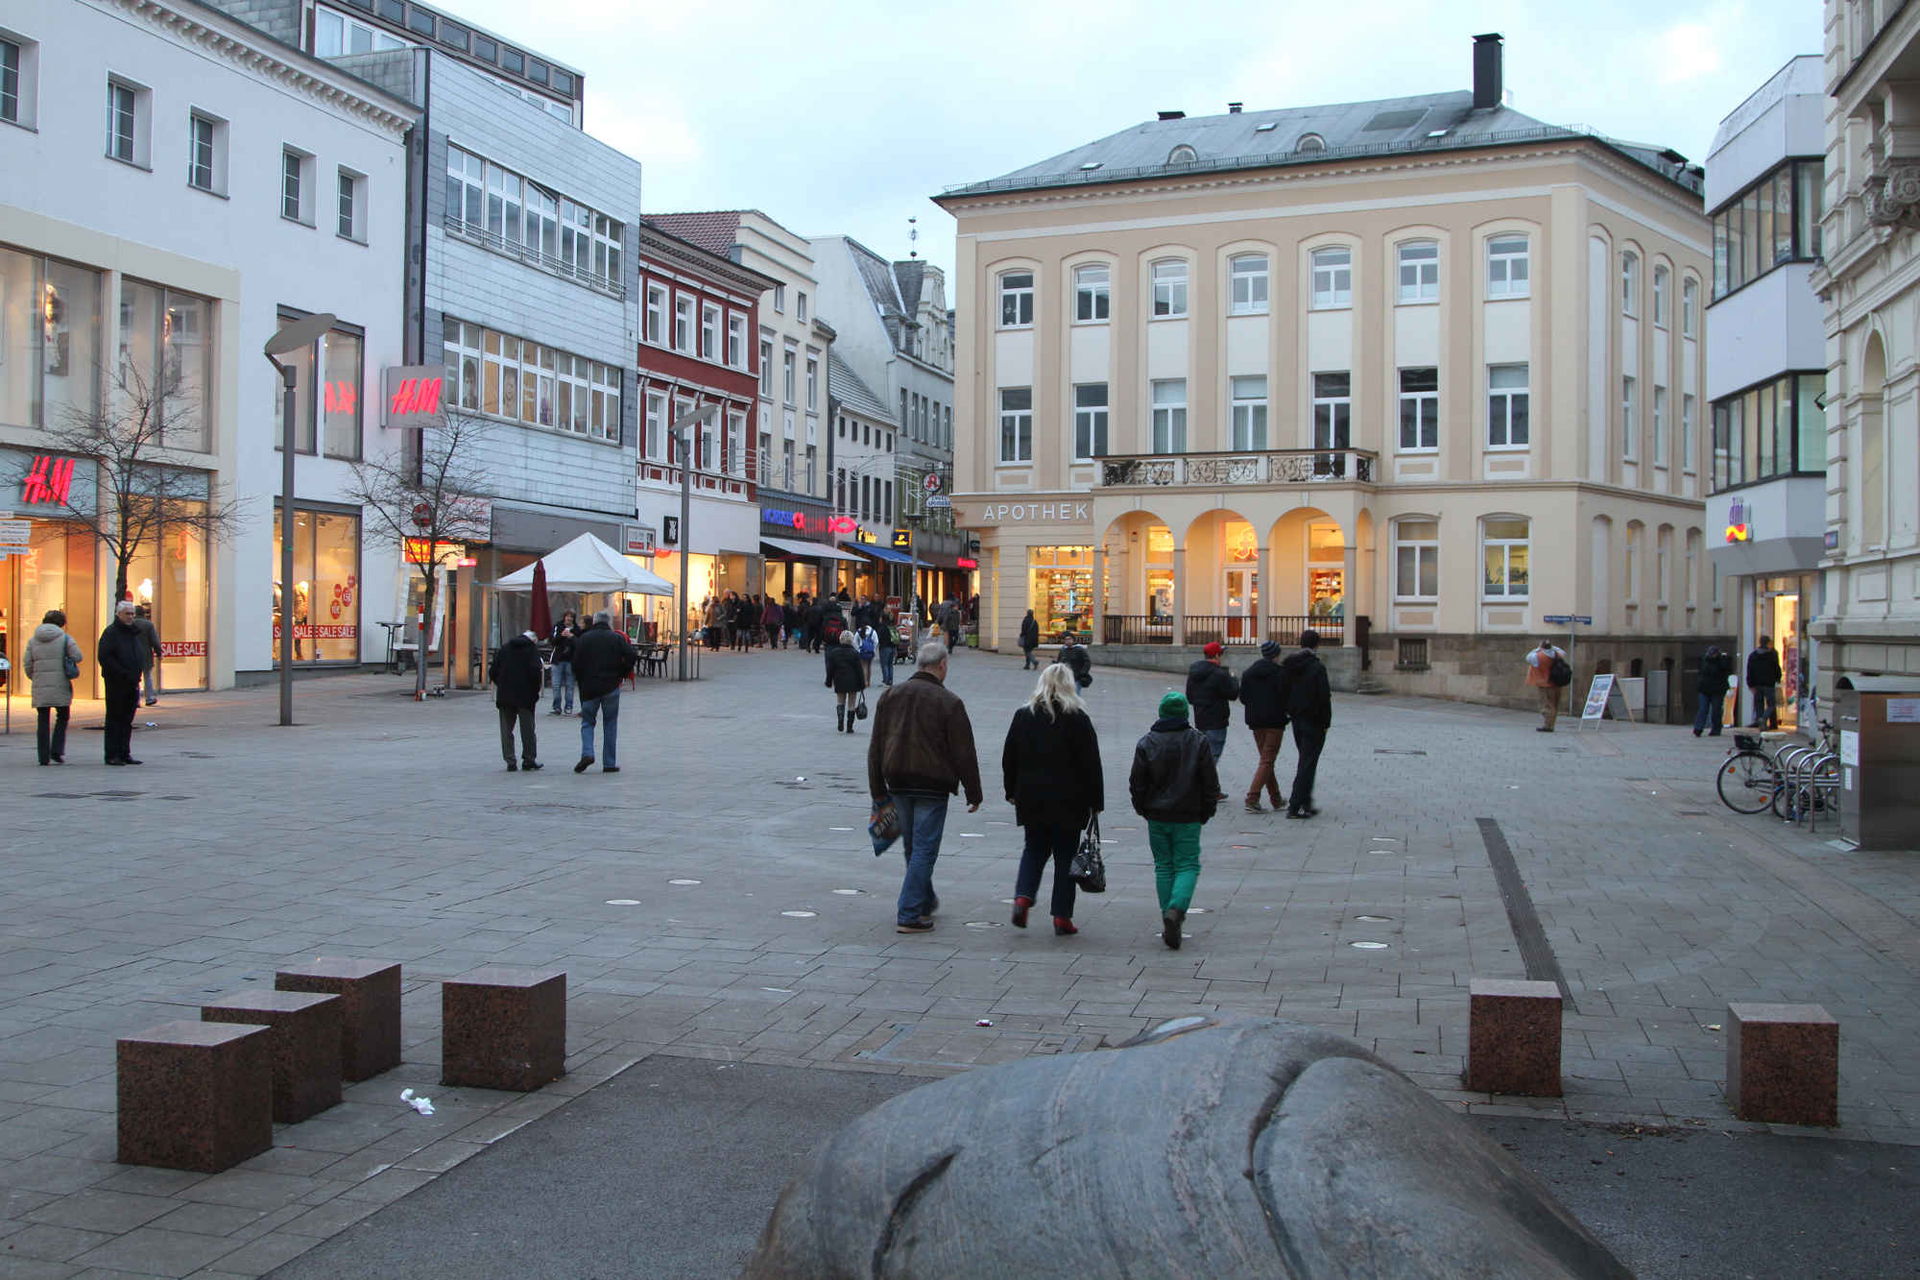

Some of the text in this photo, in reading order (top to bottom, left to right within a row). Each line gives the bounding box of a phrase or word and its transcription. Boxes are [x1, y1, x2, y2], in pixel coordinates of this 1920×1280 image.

[391, 378, 442, 415] H&M
[23, 456, 76, 507] H&M
[294, 626, 313, 637] SALE
[320, 627, 337, 638] SALE
[338, 627, 355, 638] SALE
[161, 643, 206, 656] SALE SALE
